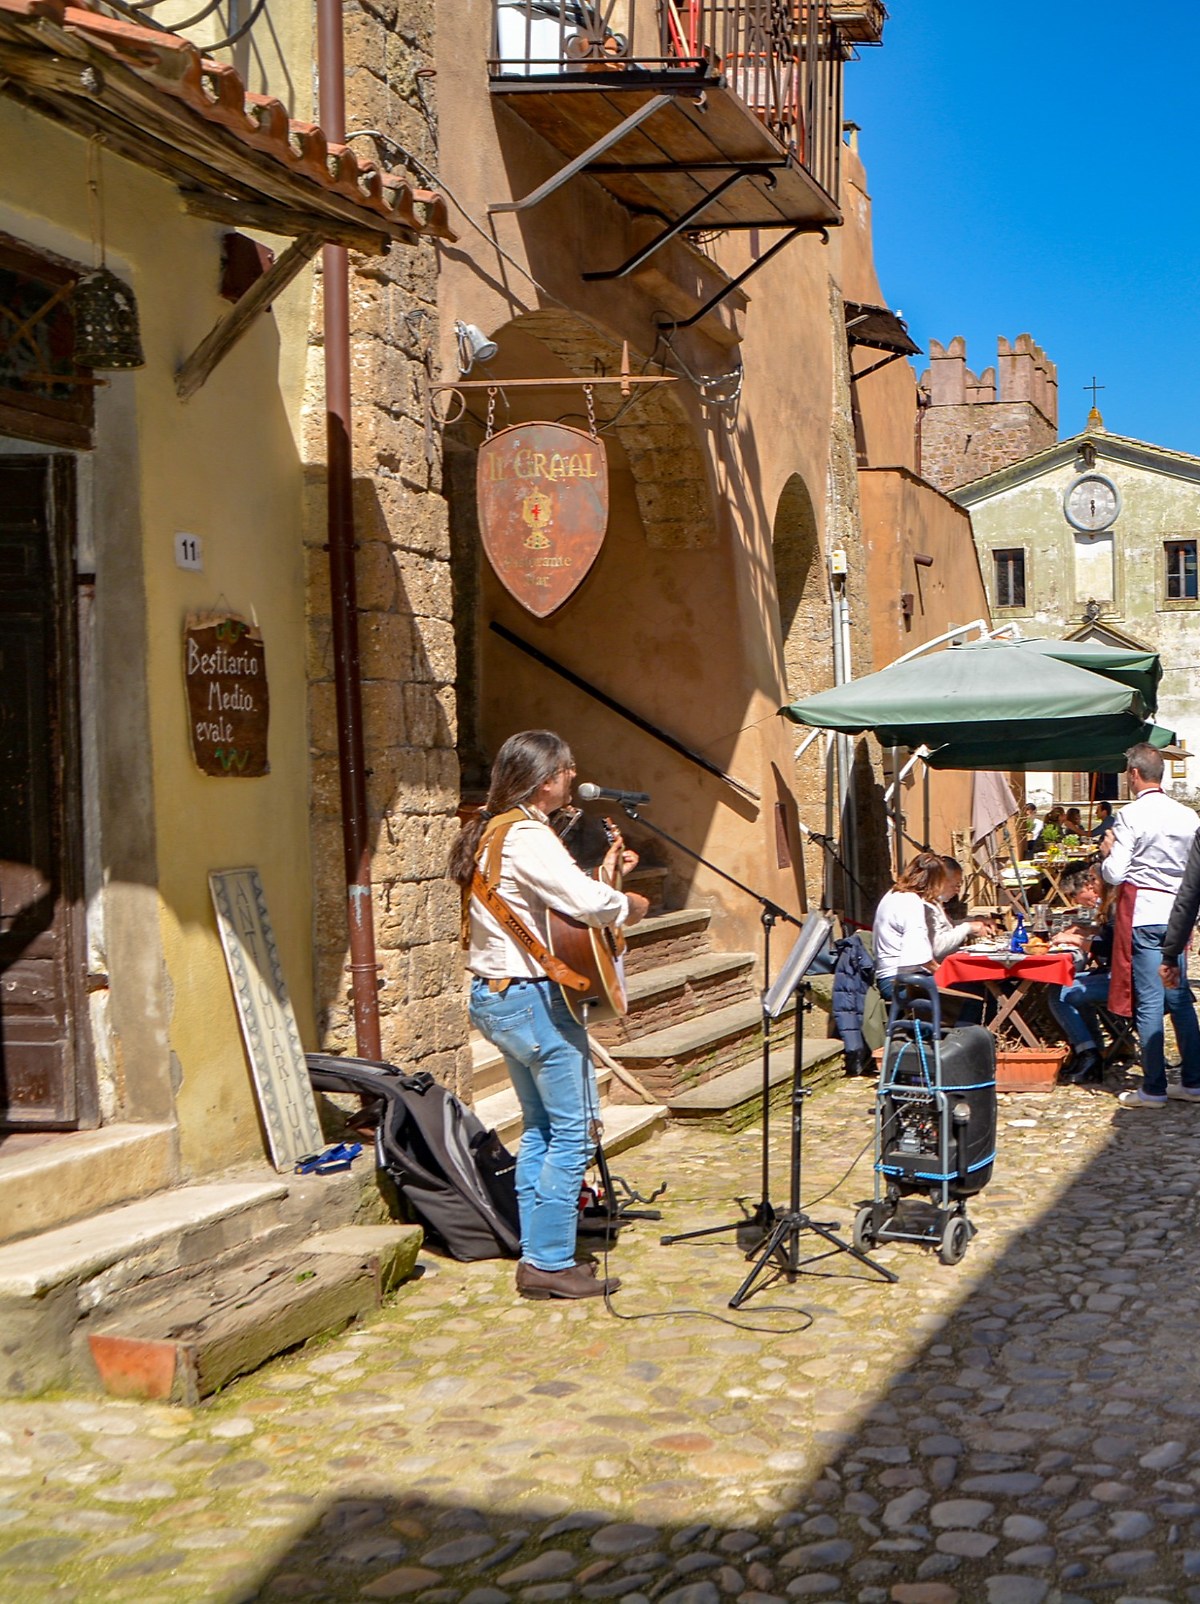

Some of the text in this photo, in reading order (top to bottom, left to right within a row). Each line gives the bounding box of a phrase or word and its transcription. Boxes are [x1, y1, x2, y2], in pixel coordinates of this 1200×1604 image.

[513, 448, 598, 482] GRAAL
[181, 539, 196, 561] 11
[188, 637, 258, 676] Bestiario
[195, 716, 235, 744] evale
[234, 879, 309, 1152] ANTIQUARIUM
